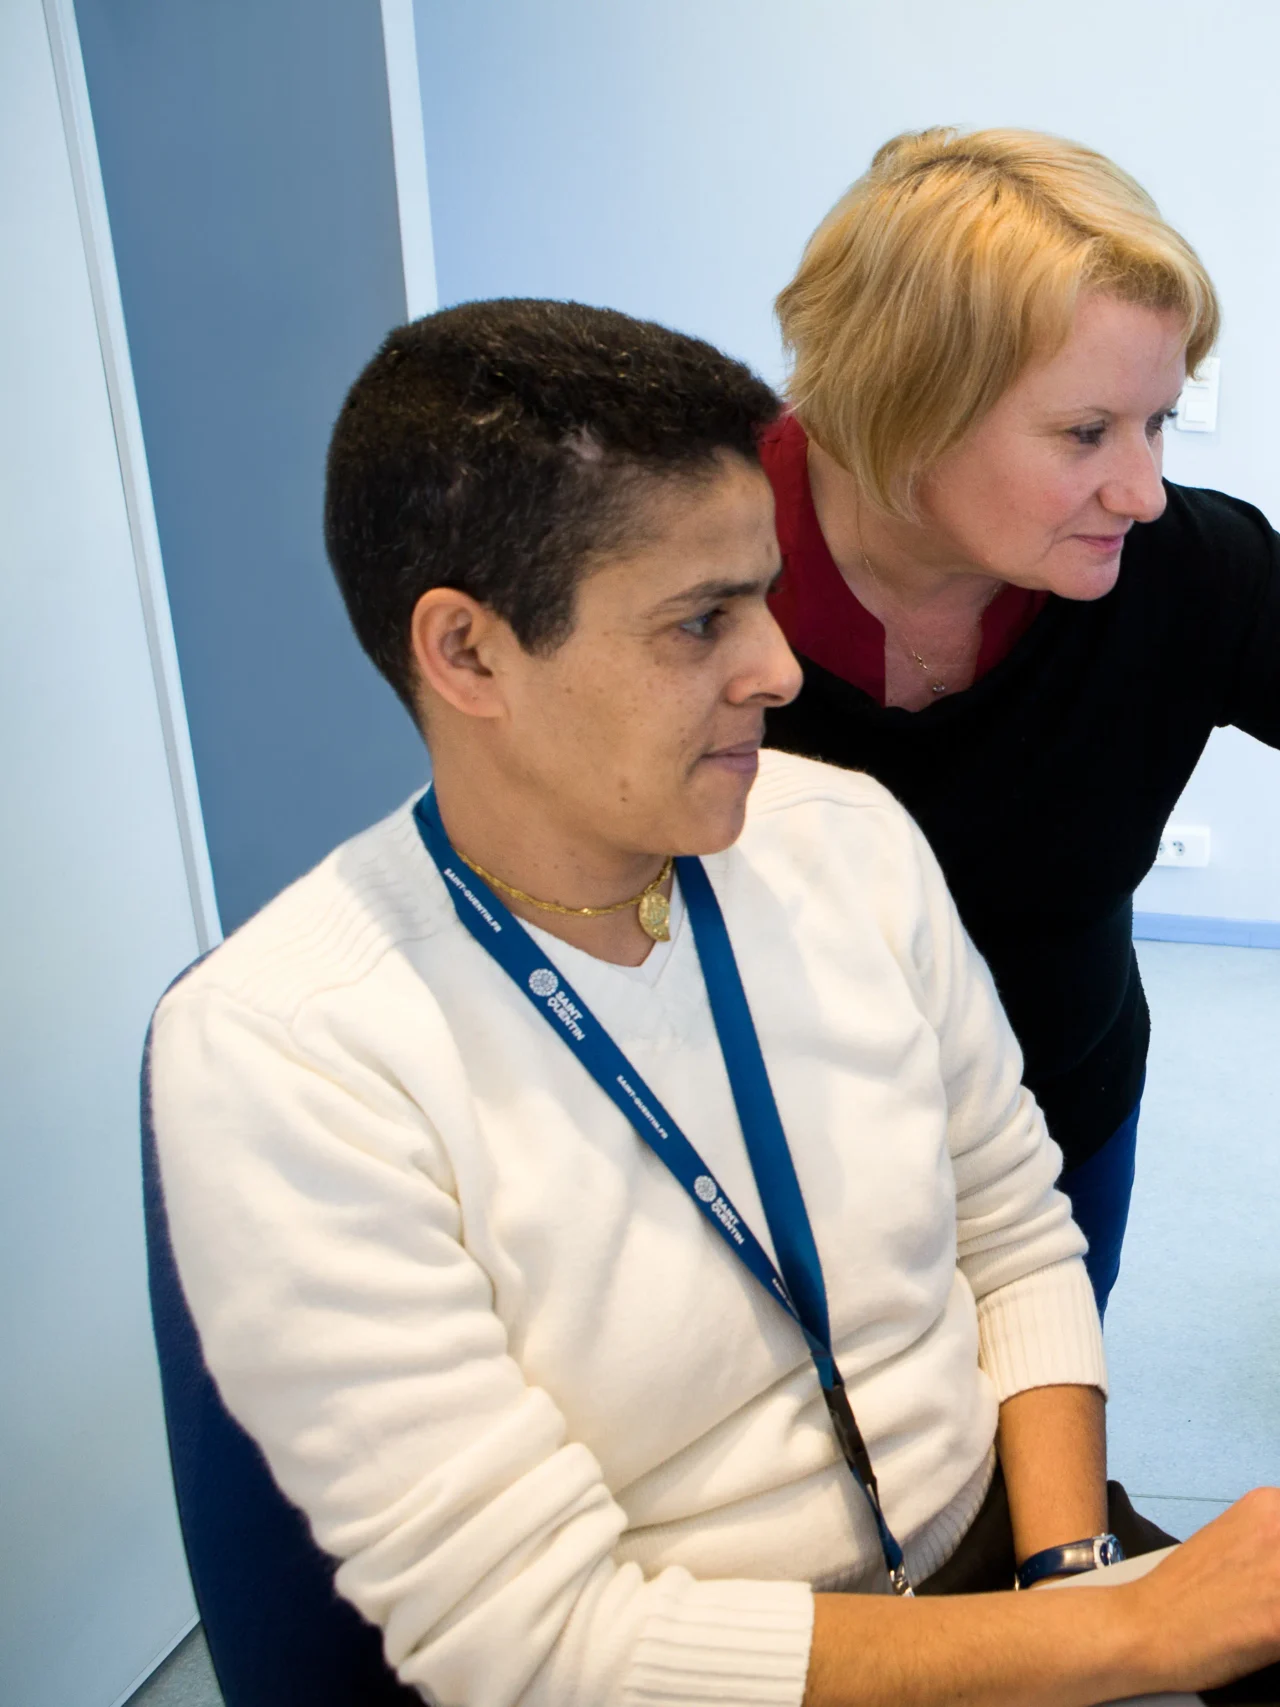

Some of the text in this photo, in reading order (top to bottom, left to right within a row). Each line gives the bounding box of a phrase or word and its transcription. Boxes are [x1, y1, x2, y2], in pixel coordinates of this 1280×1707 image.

[444, 868, 502, 933] SAINT-QUENTIN.FR
[547, 996, 585, 1041] QUENTIN
[555, 990, 583, 1021] SAINT
[710, 1202, 745, 1246] QUENTIN
[715, 1197, 740, 1225] SAINT
